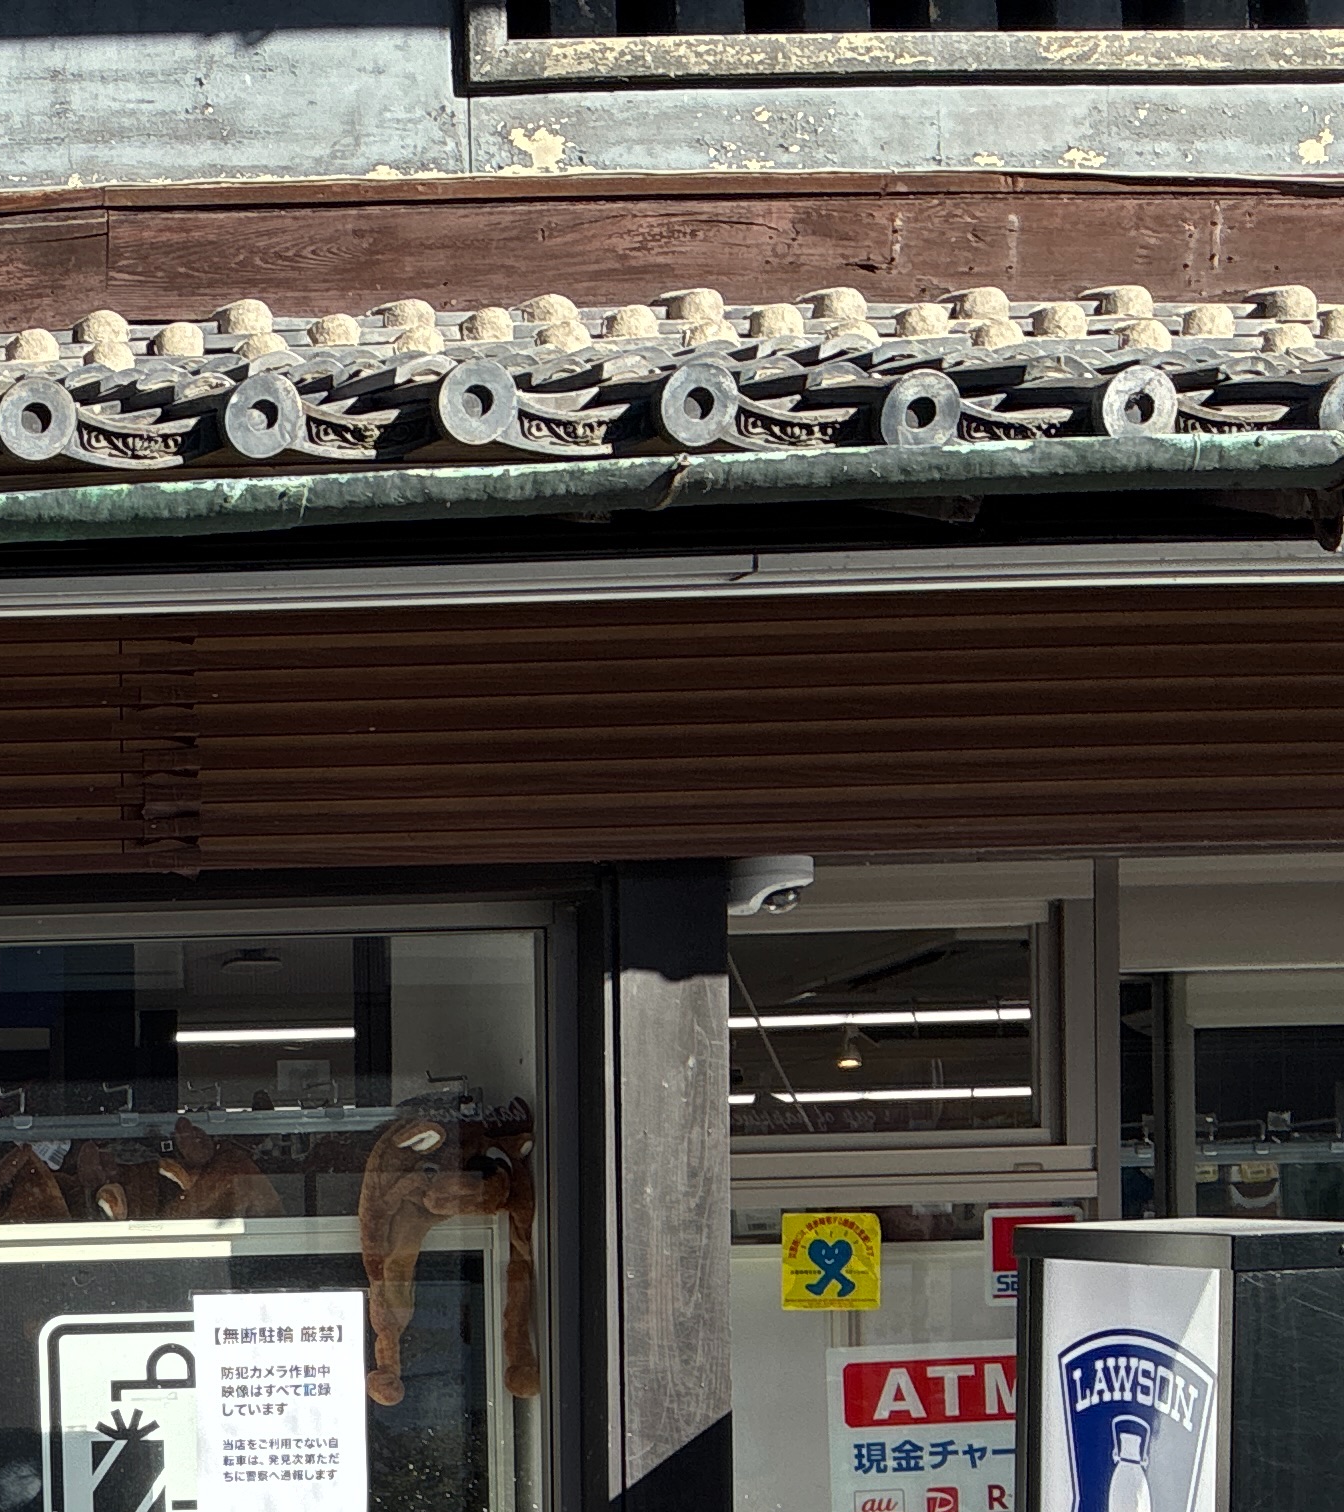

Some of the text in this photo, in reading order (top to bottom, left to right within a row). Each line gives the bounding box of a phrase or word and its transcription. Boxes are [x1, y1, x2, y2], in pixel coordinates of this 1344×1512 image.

[221, 1364, 331, 1380] 防犯カメラ作動中
[221, 1383, 331, 1399] 映像はすべて記録
[873, 1363, 1016, 1421] ATM
[1073, 1357, 1198, 1432] LAWSON
[222, 1402, 288, 1416] しています
[223, 1437, 339, 1451] 当店をご利用でない自
[853, 1439, 1016, 1474] 現金チャー
[862, 1498, 898, 1512] au
